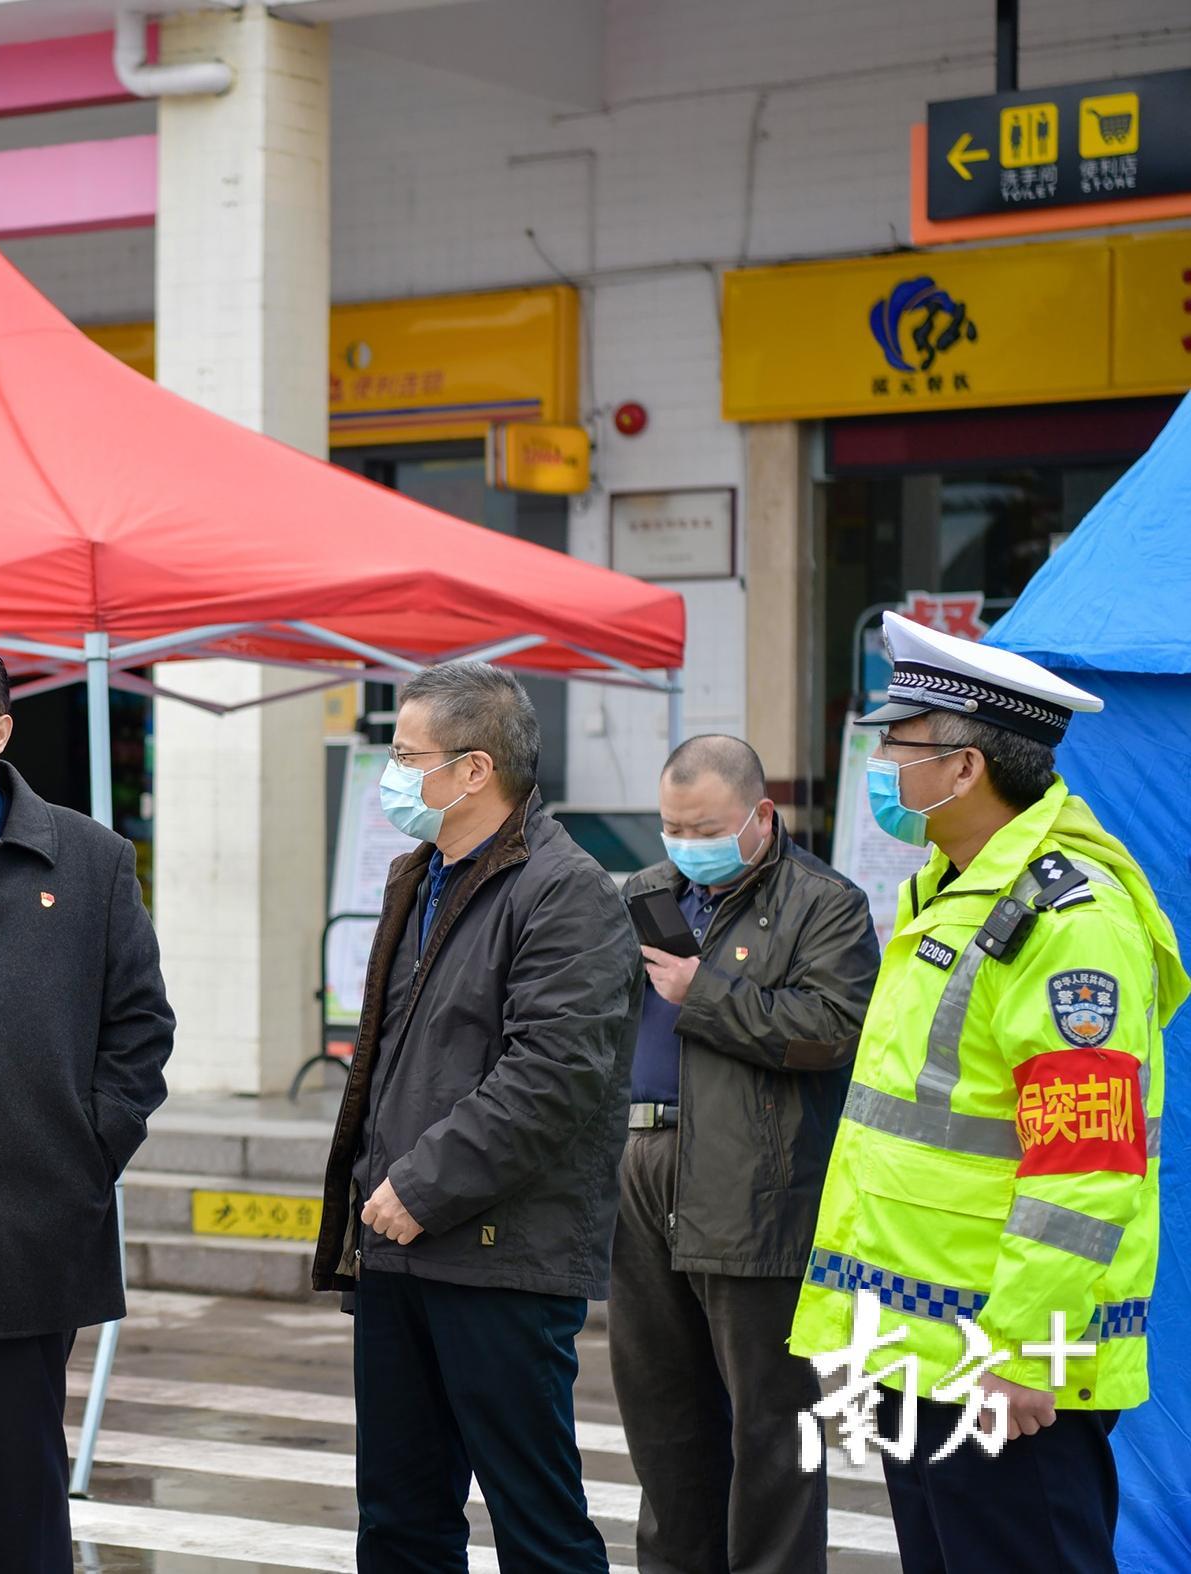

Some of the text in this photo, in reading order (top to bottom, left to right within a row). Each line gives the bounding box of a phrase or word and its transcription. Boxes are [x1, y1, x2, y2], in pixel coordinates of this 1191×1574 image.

[1000, 164, 1058, 188] 洗手间
[1080, 155, 1138, 178] 便利店
[1081, 175, 1137, 194] STORE
[1053, 974, 1114, 992] 中华人民共和国
[1058, 990, 1111, 1006] 警察
